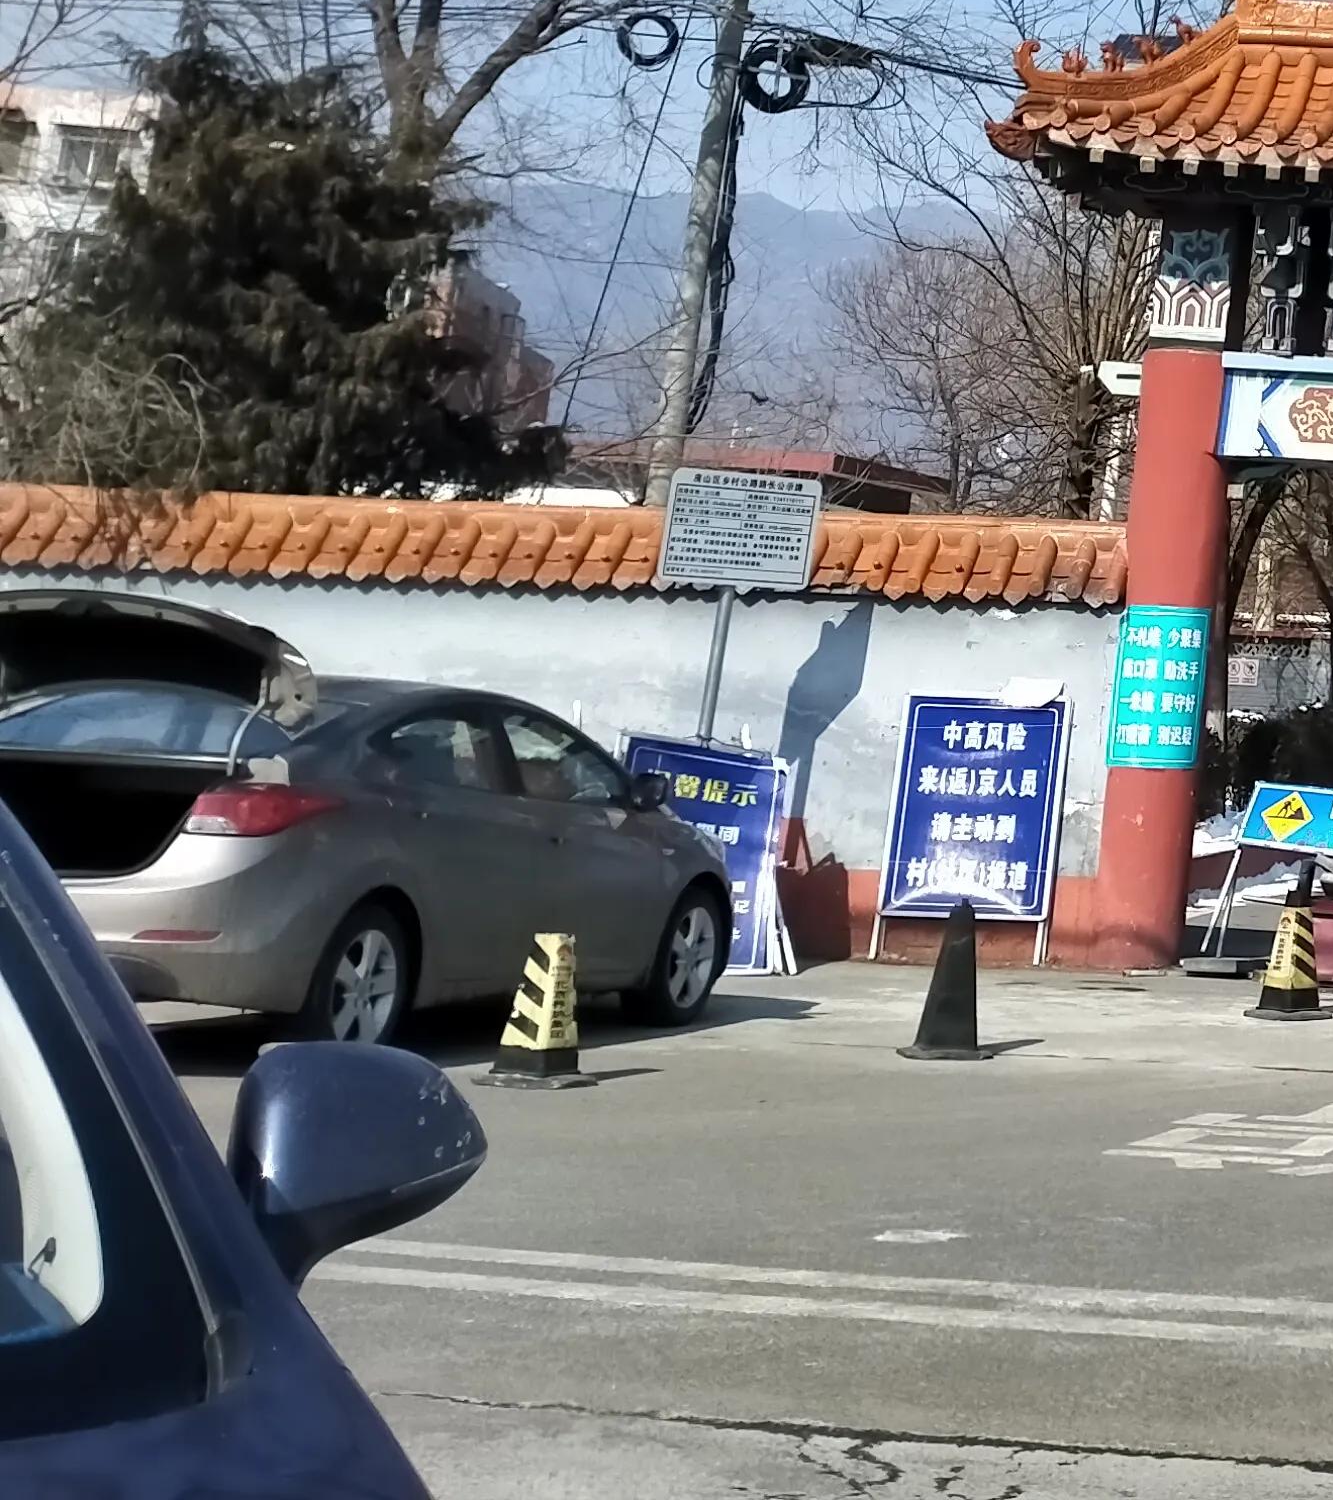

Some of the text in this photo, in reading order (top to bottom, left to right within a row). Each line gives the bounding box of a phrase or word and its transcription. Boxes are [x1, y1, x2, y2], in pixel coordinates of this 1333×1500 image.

[1163, 660, 1199, 681] 勤洗手
[943, 718, 1029, 751] 中高风险
[648, 768, 758, 807] 馨提示
[931, 811, 1017, 844] 请主动到
